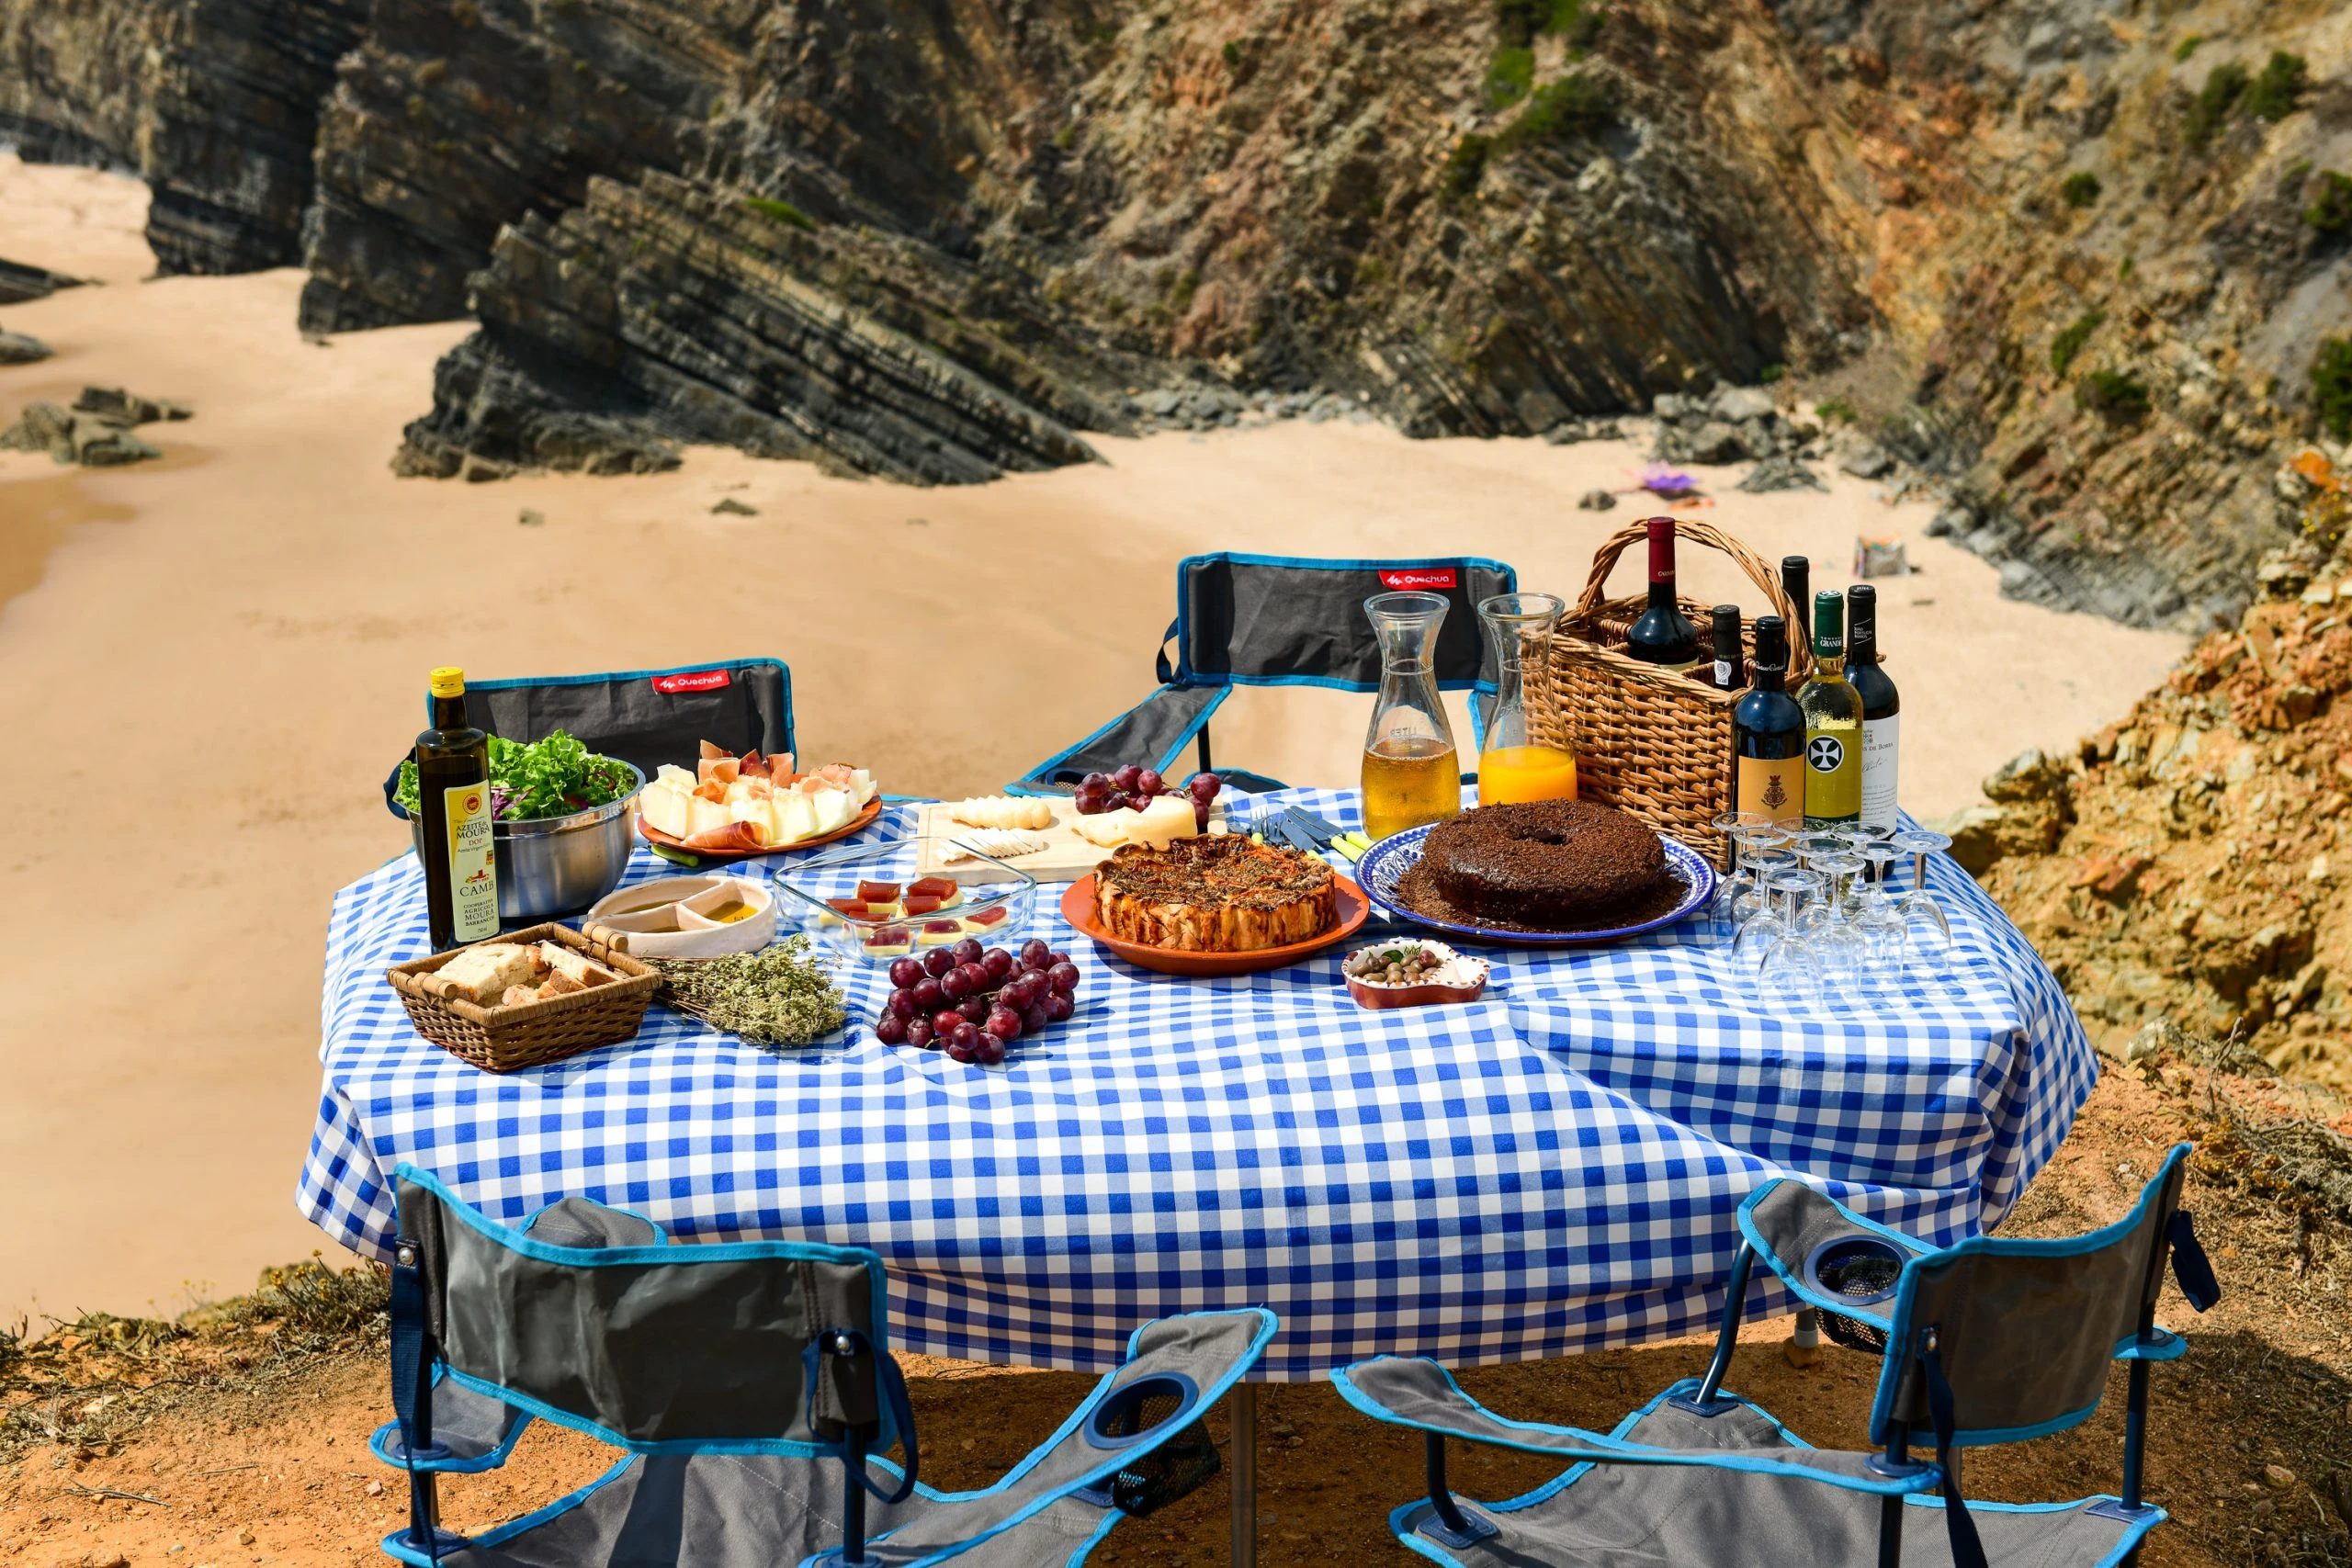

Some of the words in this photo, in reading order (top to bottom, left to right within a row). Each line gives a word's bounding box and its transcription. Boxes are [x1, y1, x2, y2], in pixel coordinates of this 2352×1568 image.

[1405, 575, 1450, 584] Quechua
[678, 675, 722, 686] Quechua
[457, 821, 482, 831] AZEITE
[456, 825, 490, 840] MOURA
[469, 838, 482, 846] DOP
[459, 880, 494, 897] CAMB
[465, 908, 494, 920] MOURA
